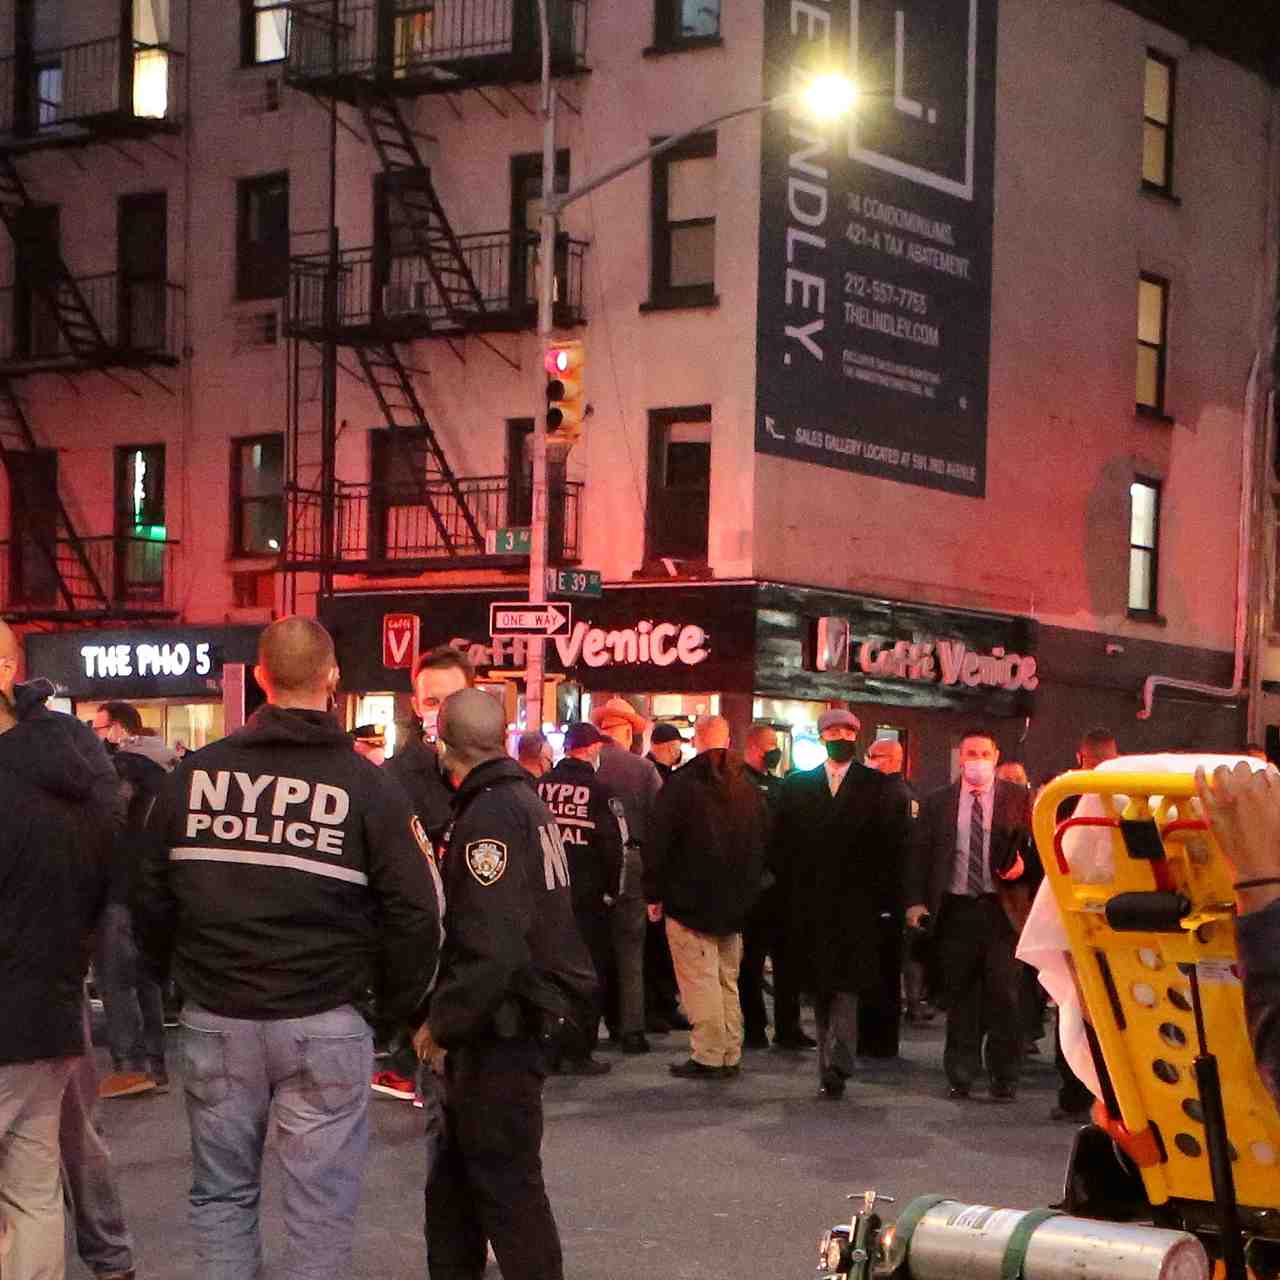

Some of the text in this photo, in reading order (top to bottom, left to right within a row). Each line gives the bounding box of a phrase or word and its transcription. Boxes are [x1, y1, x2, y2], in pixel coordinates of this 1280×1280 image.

[505, 530, 515, 551] 3
[558, 572, 567, 590] E
[571, 573, 587, 592] 39
[502, 614, 559, 626] ONE WAY
[80, 642, 211, 678] THE PHO 5
[388, 630, 411, 664] V
[553, 618, 708, 668] Venice
[935, 639, 1040, 692] Venice
[188, 769, 350, 826] NYPD
[185, 812, 345, 856] POLICE
